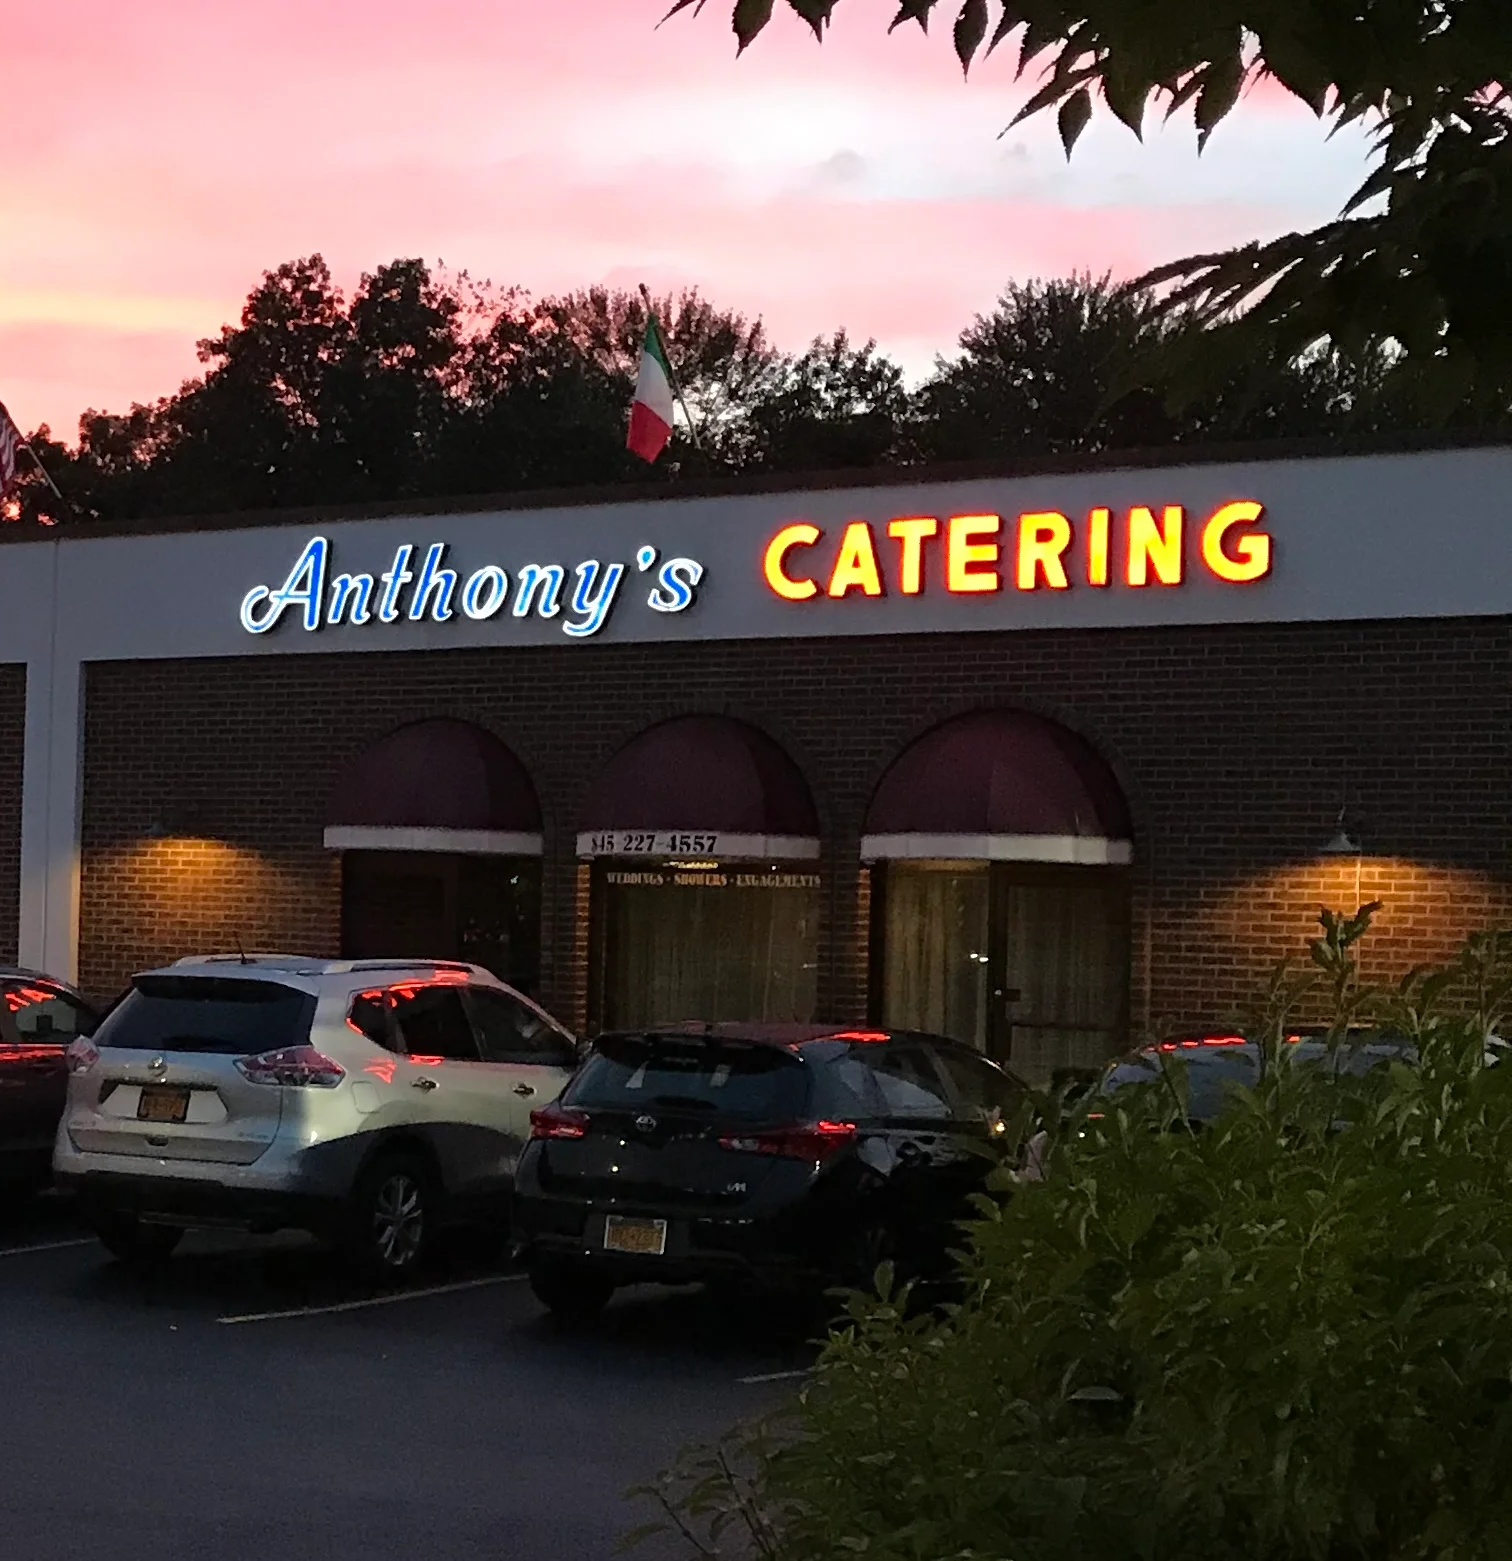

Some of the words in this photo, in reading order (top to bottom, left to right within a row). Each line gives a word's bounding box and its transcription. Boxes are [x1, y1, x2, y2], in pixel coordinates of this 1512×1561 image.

[240, 535, 704, 638] Anthony's
[764, 500, 1272, 601] CATERING
[607, 871, 665, 886] WEDDINGS
[674, 872, 728, 887] SHOWERS
[736, 874, 822, 888] ENGAGEMENTS
